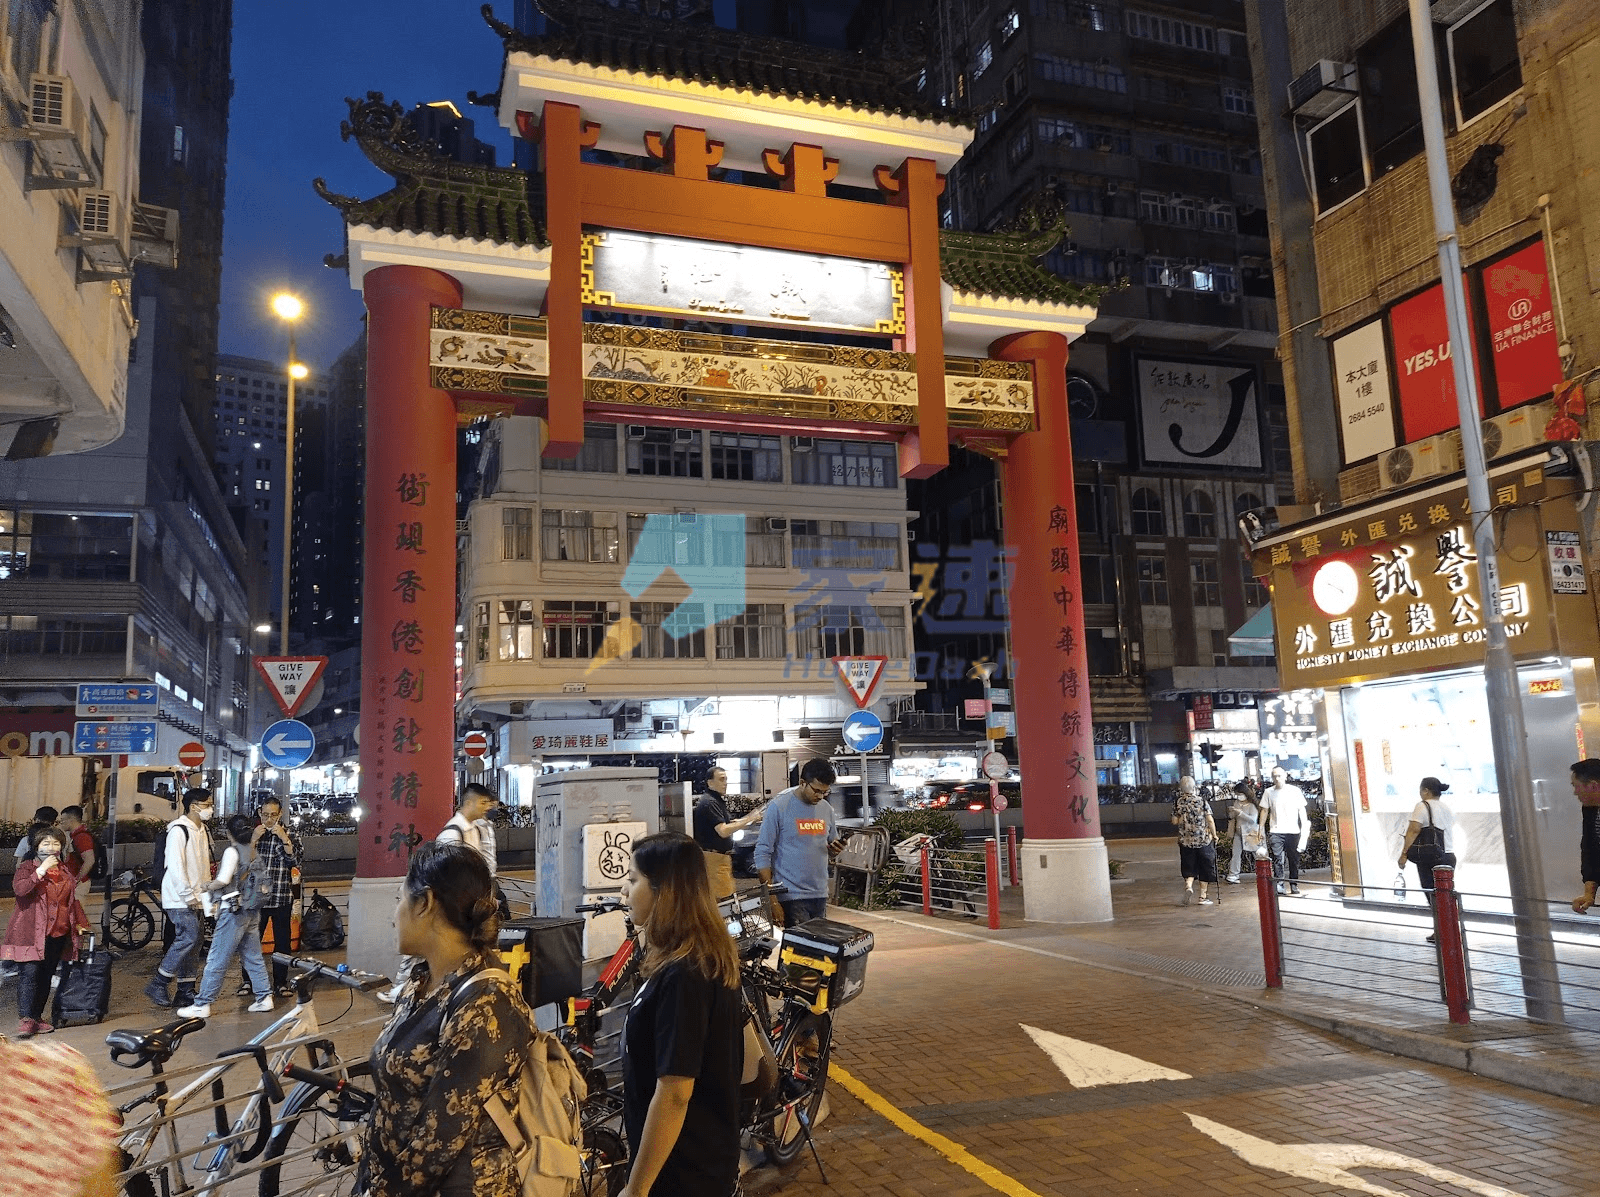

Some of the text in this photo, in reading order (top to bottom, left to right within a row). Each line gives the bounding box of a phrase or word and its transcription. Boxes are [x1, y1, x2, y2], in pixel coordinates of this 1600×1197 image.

[1495, 321, 1554, 352] UA FINANCE
[1404, 340, 1453, 376] YES,U
[1346, 645, 1388, 662] MONEY
[1391, 633, 1459, 656] EXCHANGE
[1461, 621, 1529, 644] COMNY
[279, 663, 303, 672] GIVE
[279, 673, 303, 681] WAY
